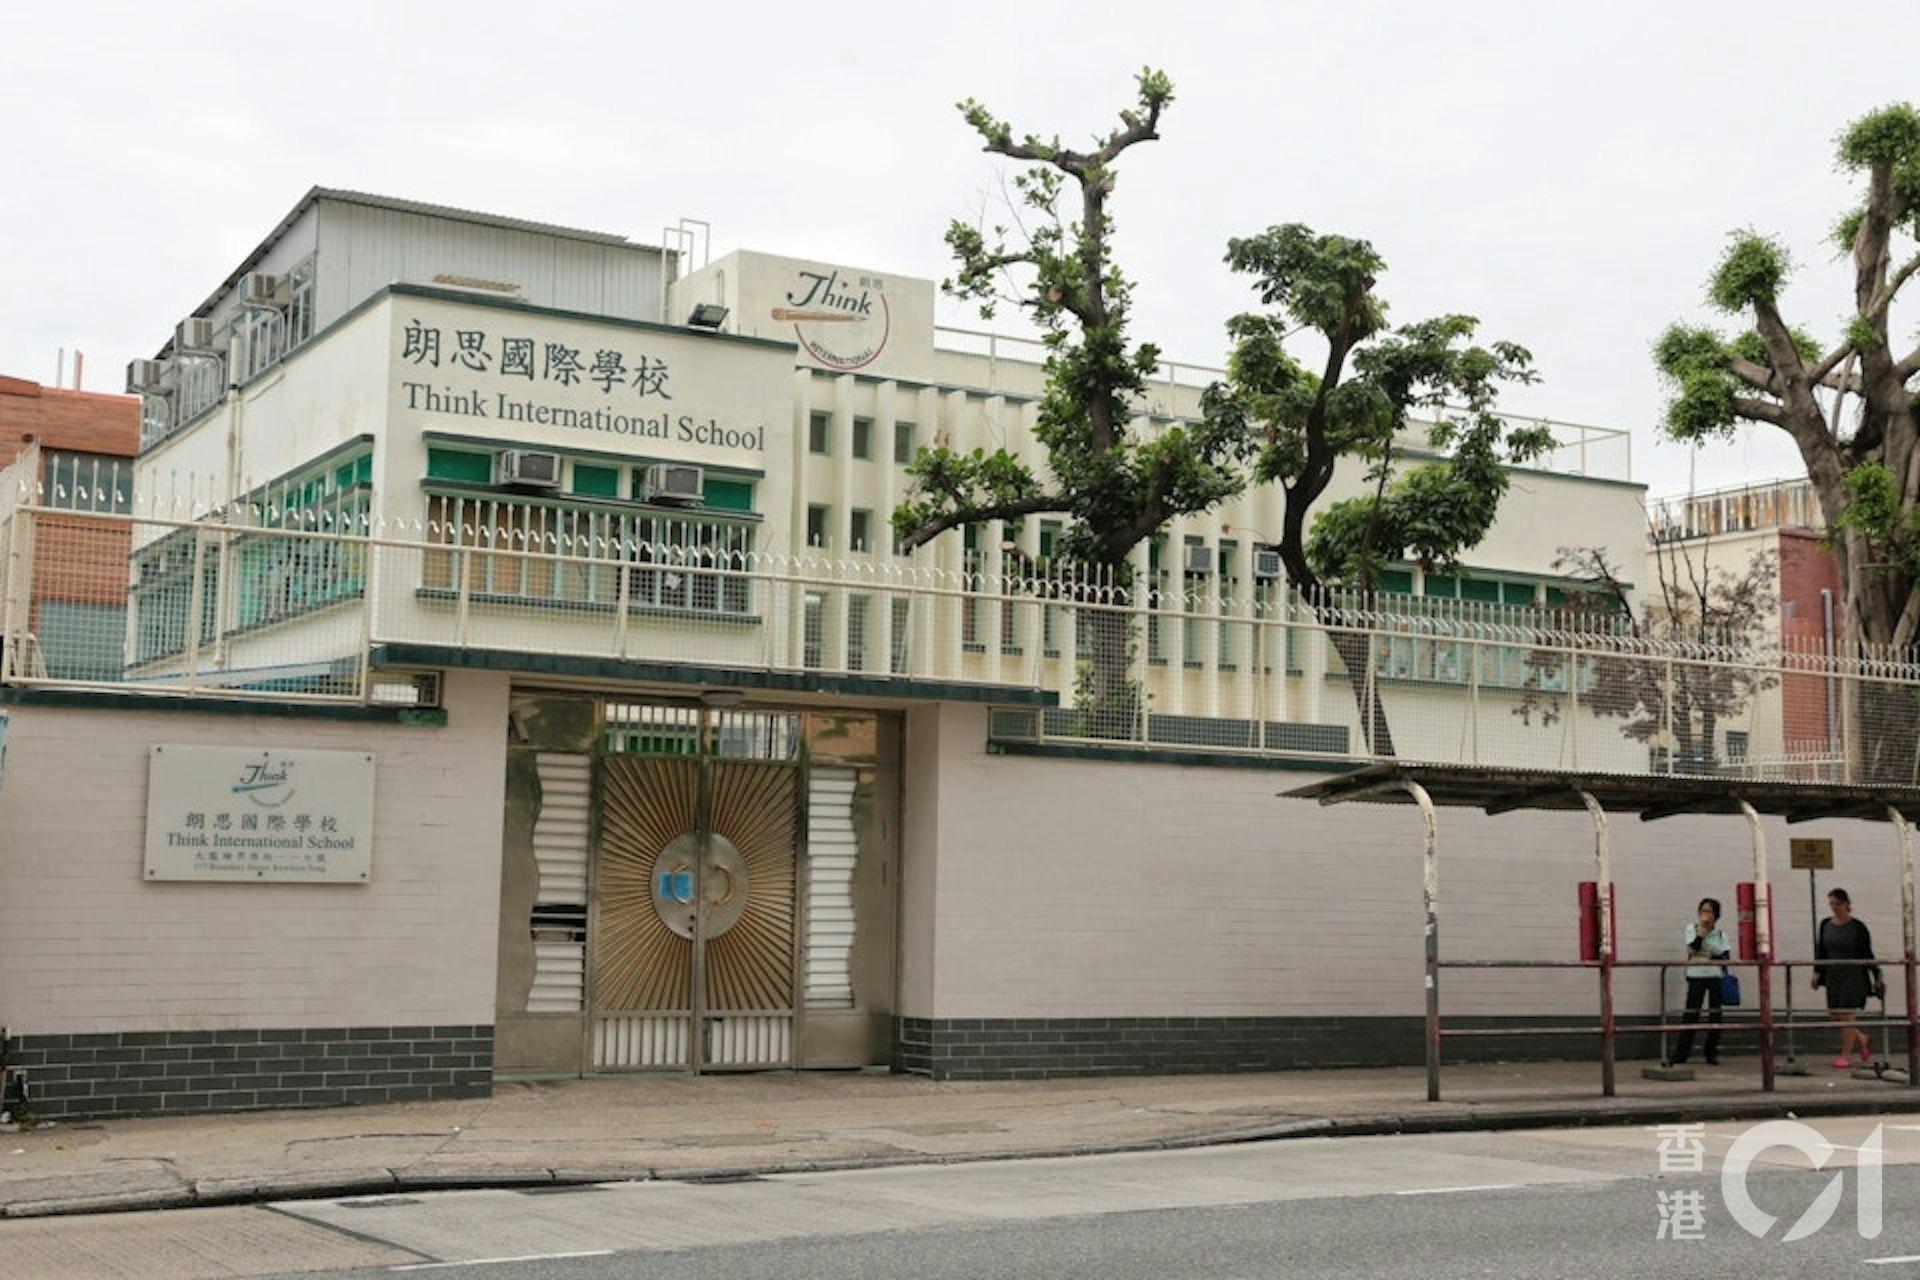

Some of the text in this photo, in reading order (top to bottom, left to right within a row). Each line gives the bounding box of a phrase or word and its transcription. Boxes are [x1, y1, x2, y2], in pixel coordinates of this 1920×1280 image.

[786, 270, 873, 315] Think
[402, 318, 672, 400] 朗思國際學校
[402, 382, 765, 451] Think International School
[167, 832, 355, 849] Think International School
[185, 812, 338, 833] 朗思國際學校
